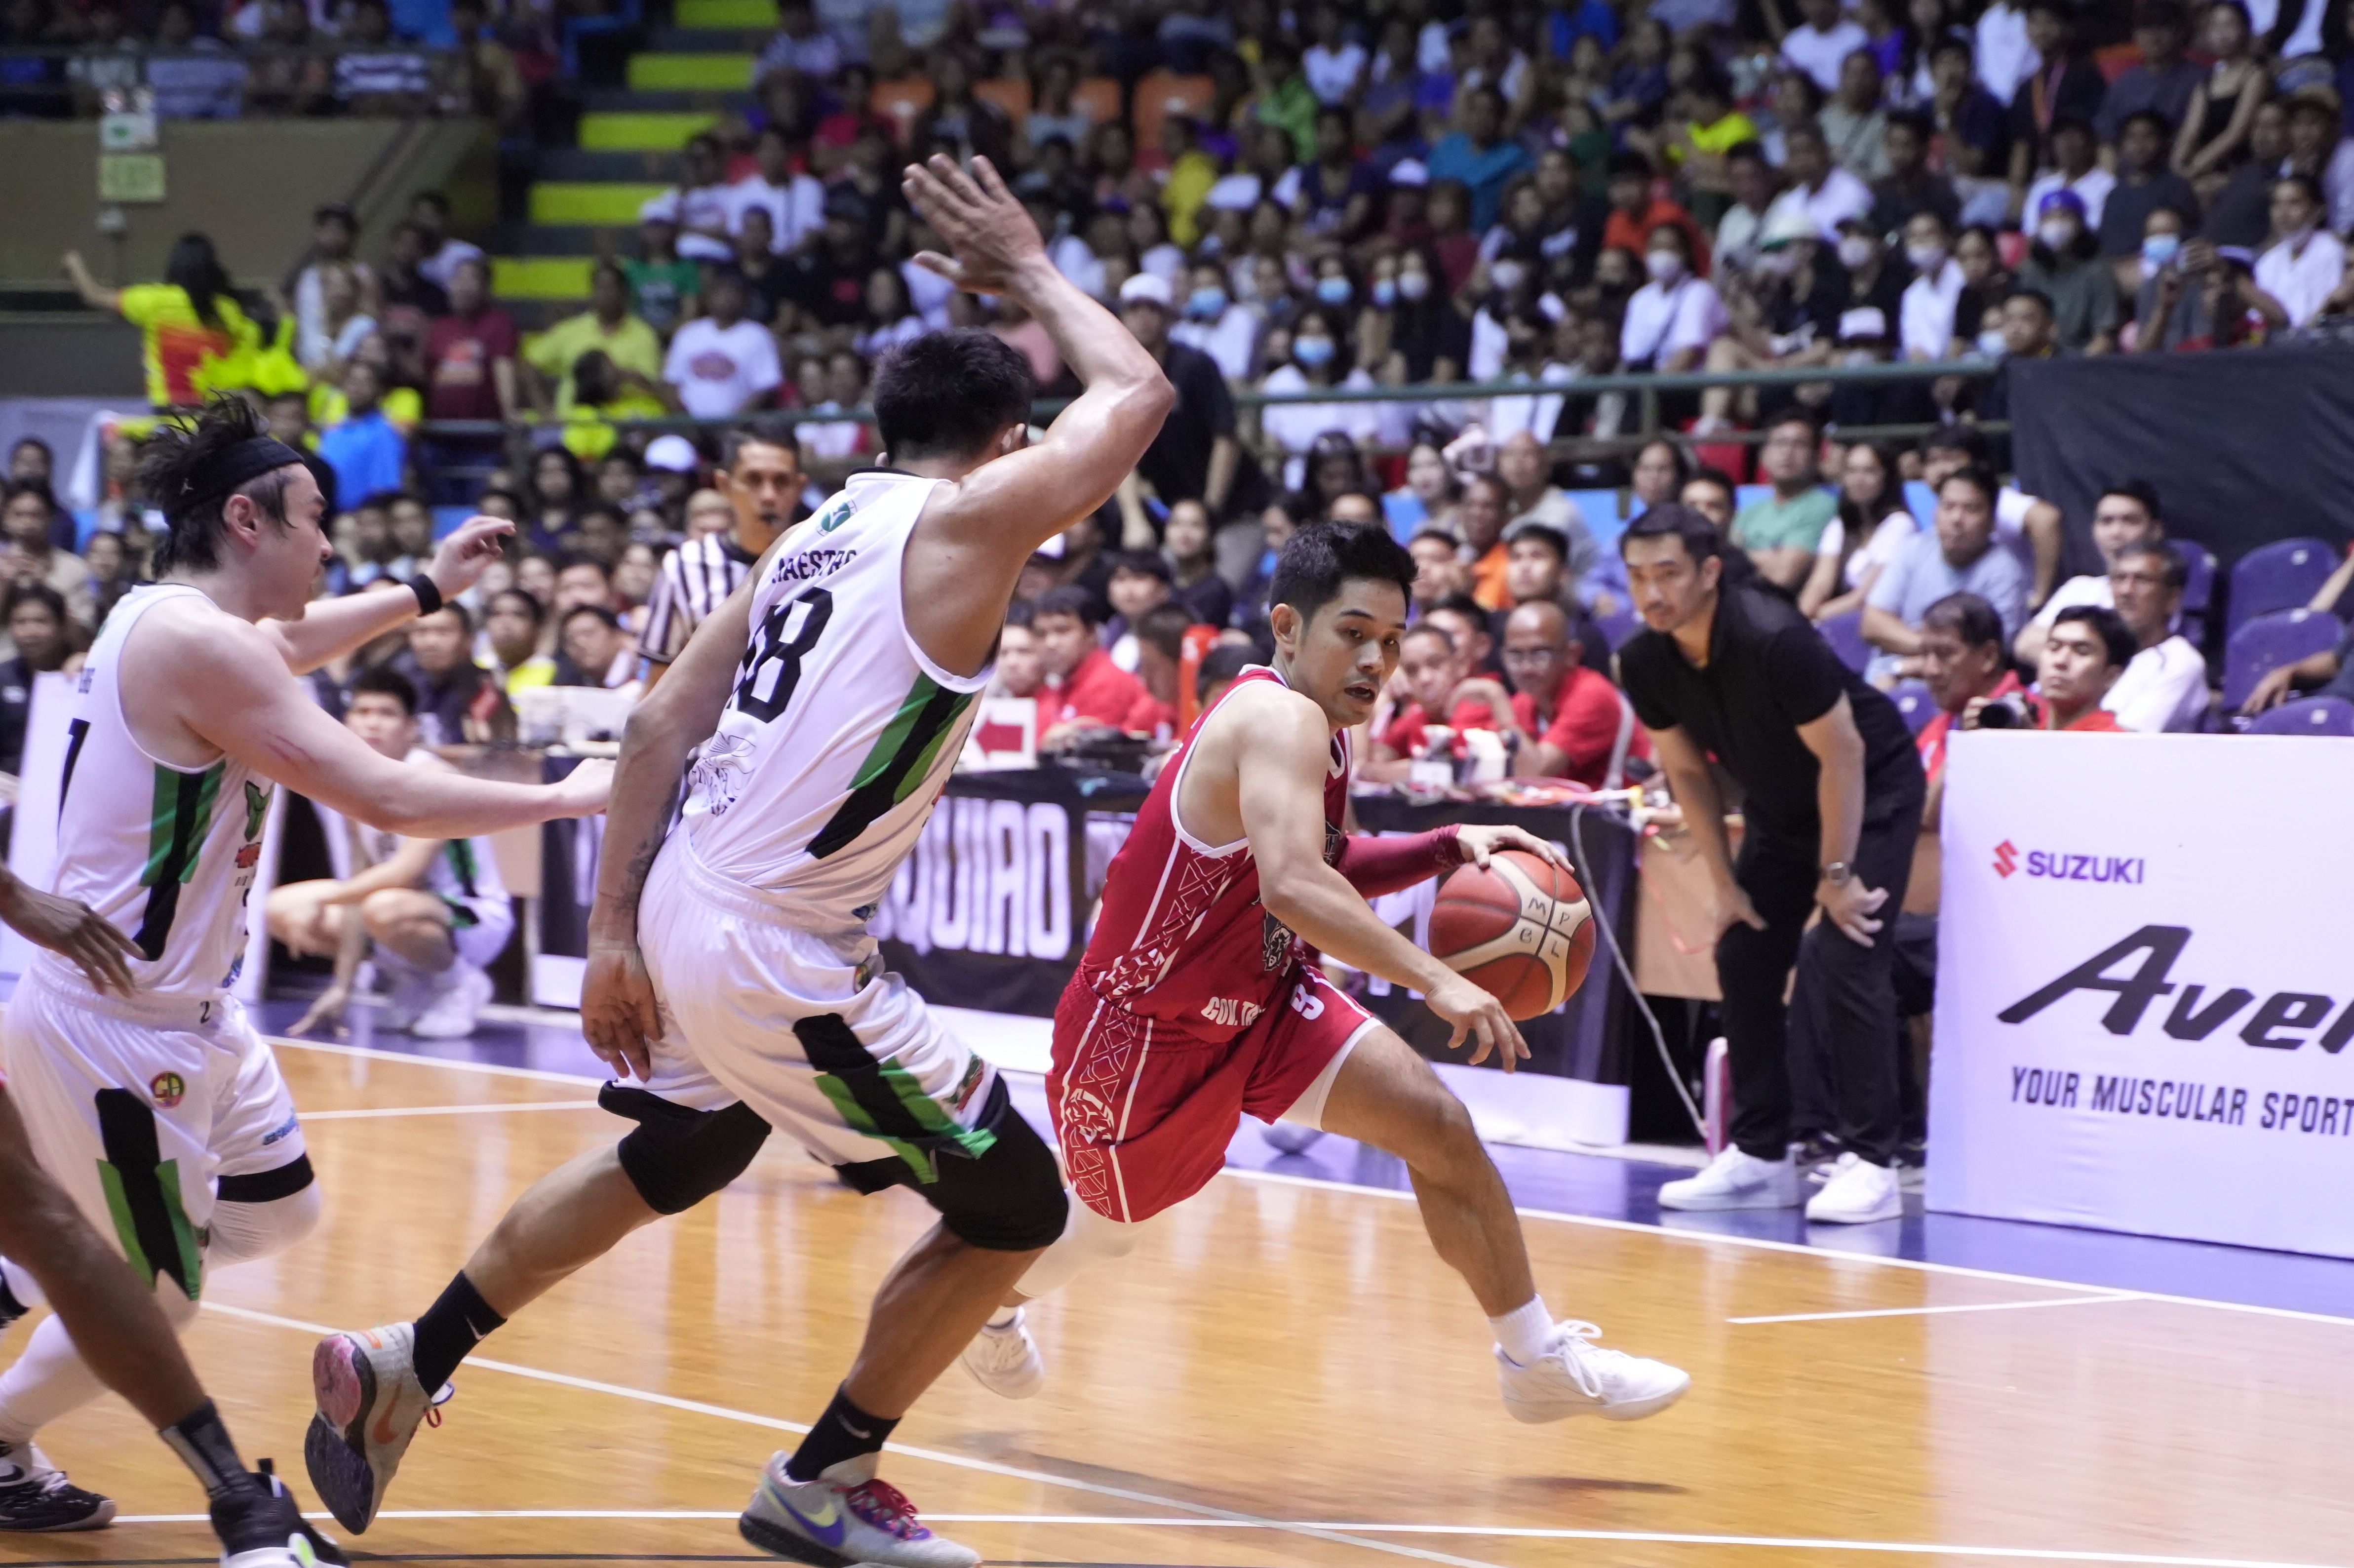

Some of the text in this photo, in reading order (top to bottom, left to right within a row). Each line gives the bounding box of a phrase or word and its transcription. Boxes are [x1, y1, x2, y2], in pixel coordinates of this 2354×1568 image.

[2027, 850, 2144, 883] SUZUKI
[1528, 897, 1570, 925] M P
[1551, 940, 1560, 958] L
[2012, 1065, 2079, 1108] YOUR
[2091, 1074, 2247, 1125] MUSCULAR
